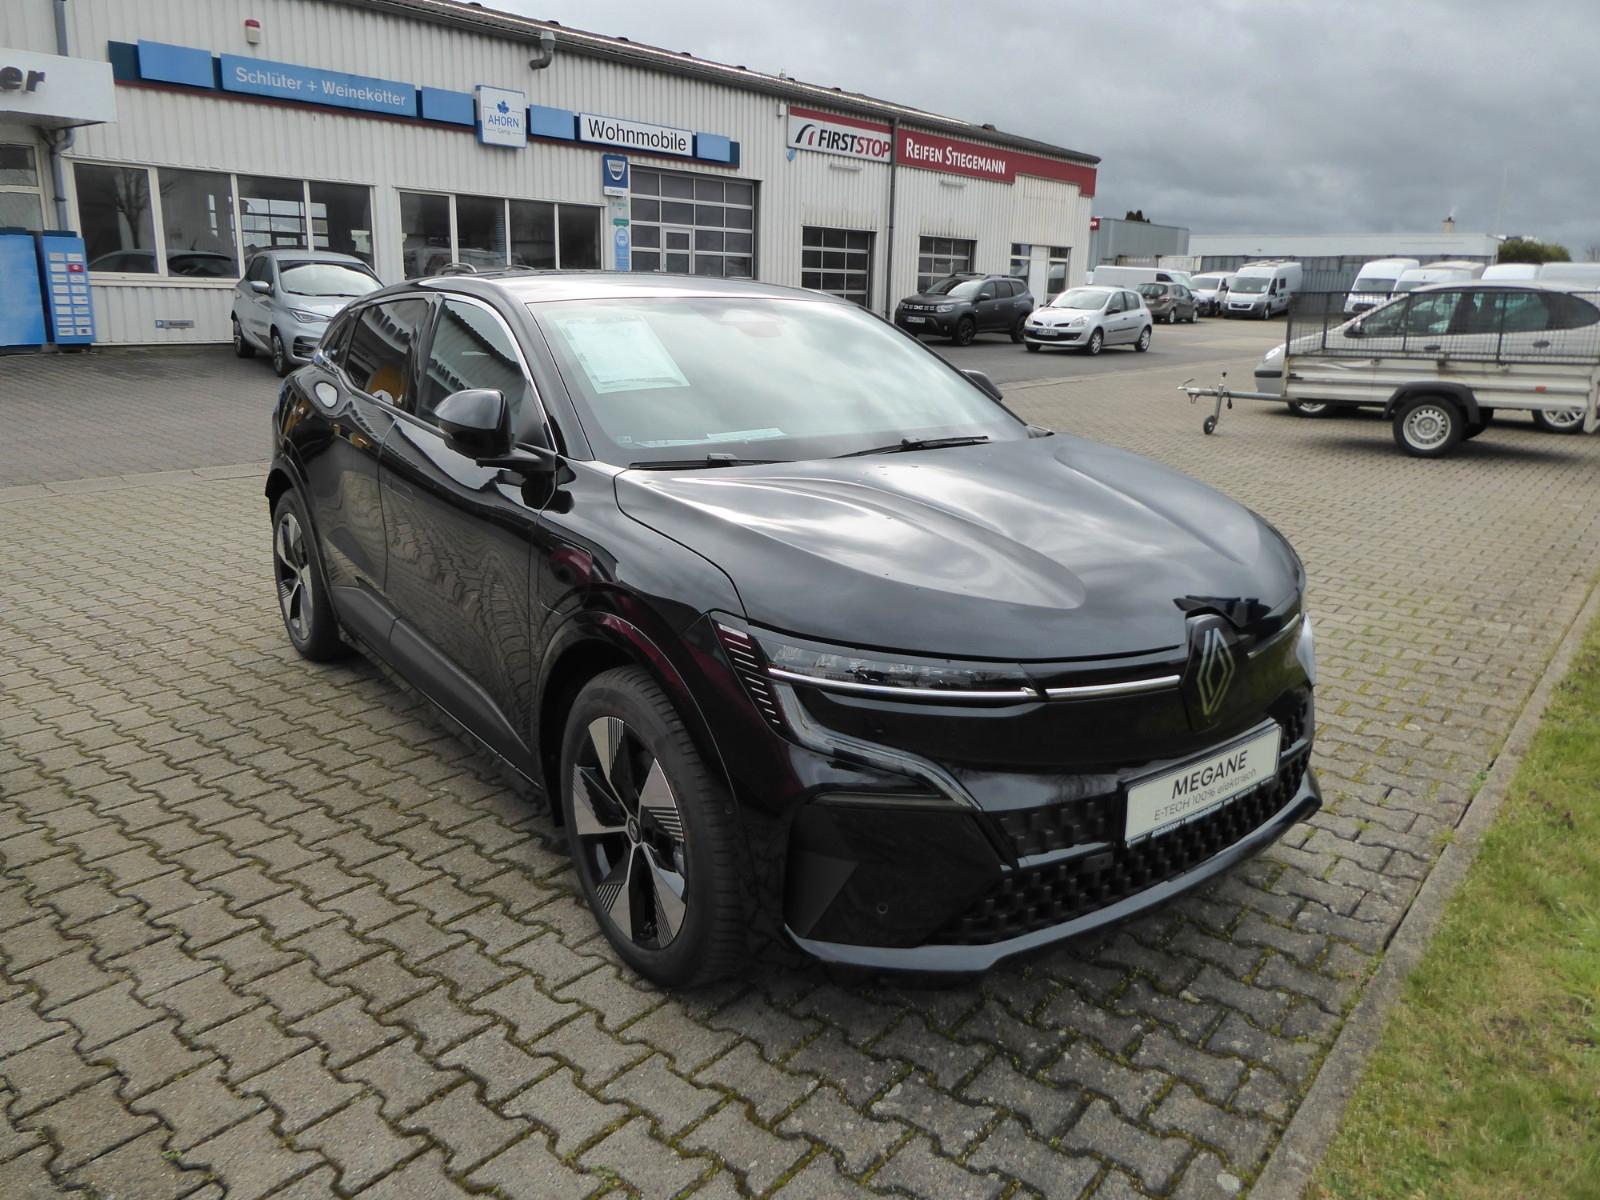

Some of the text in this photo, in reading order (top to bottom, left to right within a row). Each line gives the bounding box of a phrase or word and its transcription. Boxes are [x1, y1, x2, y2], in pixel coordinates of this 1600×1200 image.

[235, 66, 406, 107] Schlüter + Weinekötter
[488, 113, 520, 128] AHORN
[588, 118, 687, 151] Wohnmobile
[817, 128, 891, 158] FIRSTSTOP
[1171, 750, 1249, 800] MEGANE
[1154, 800, 1190, 822] E-TECH
